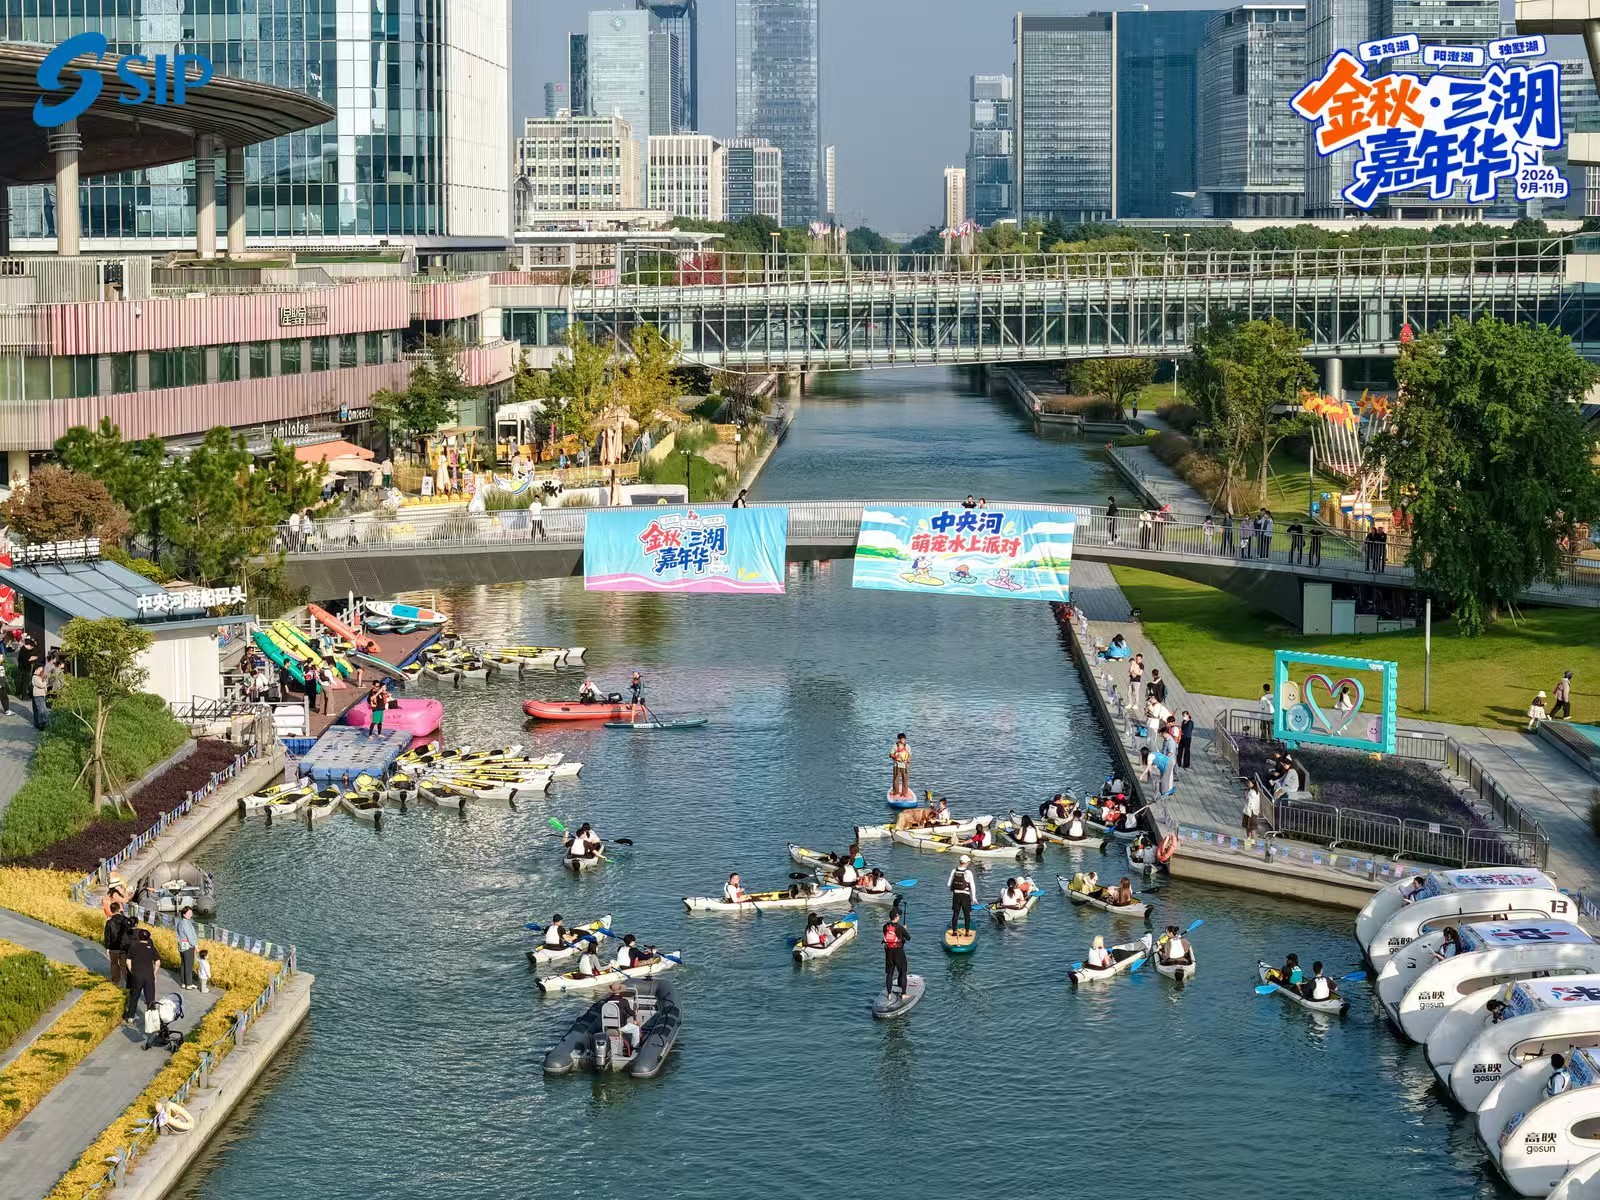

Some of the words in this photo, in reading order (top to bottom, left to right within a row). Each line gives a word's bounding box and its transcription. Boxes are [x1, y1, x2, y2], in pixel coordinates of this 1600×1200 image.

[931, 511, 1004, 534] 中央河
[911, 534, 1021, 557] 萌宠水上派对
[655, 547, 709, 573] 嘉年华
[136, 586, 247, 612] 中央河游船码头
[1550, 900, 1568, 914] 13
[1419, 1002, 1445, 1011] gosun
[1473, 1075, 1501, 1084] gosun
[1526, 1145, 1556, 1155] gosun
